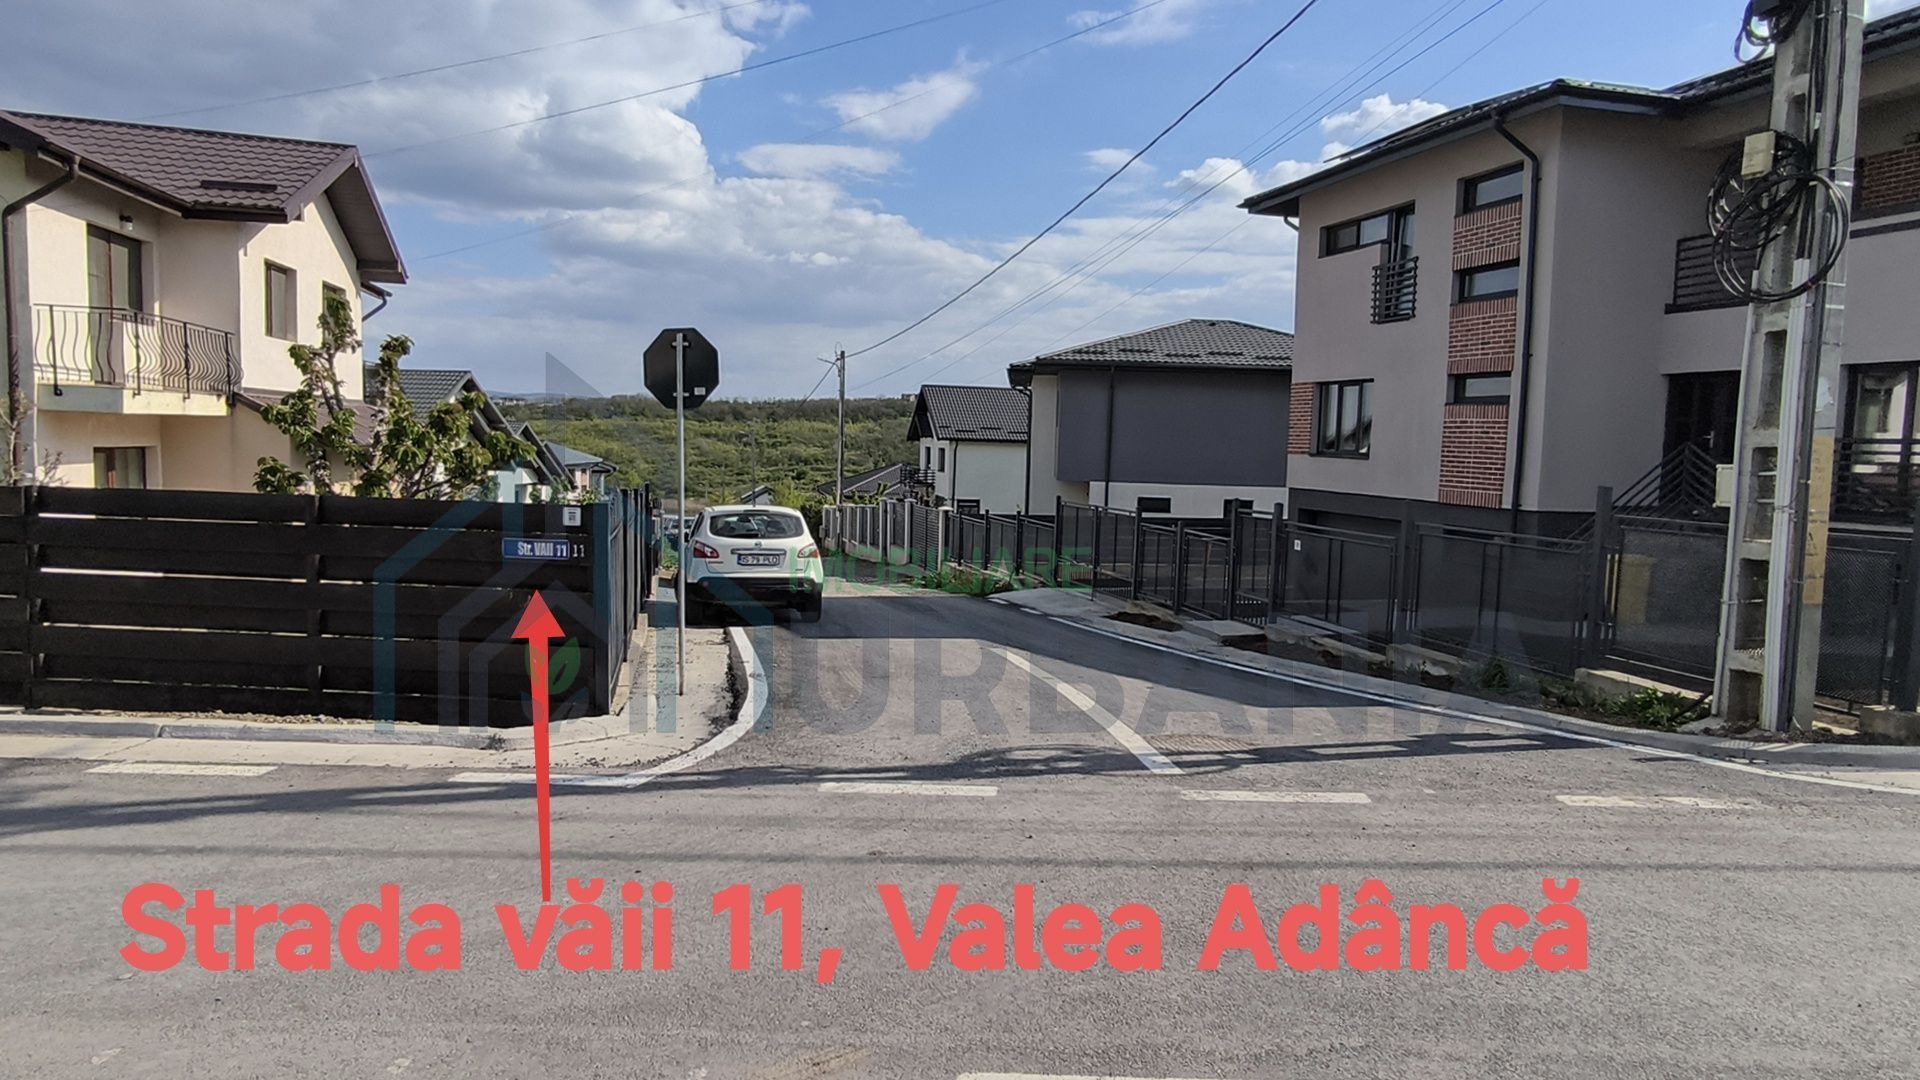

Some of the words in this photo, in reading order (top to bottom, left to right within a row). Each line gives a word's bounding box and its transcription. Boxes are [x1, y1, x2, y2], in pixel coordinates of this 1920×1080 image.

[517, 541, 533, 556] Str.
[556, 544, 567, 557] 11
[573, 544, 585, 557] 11
